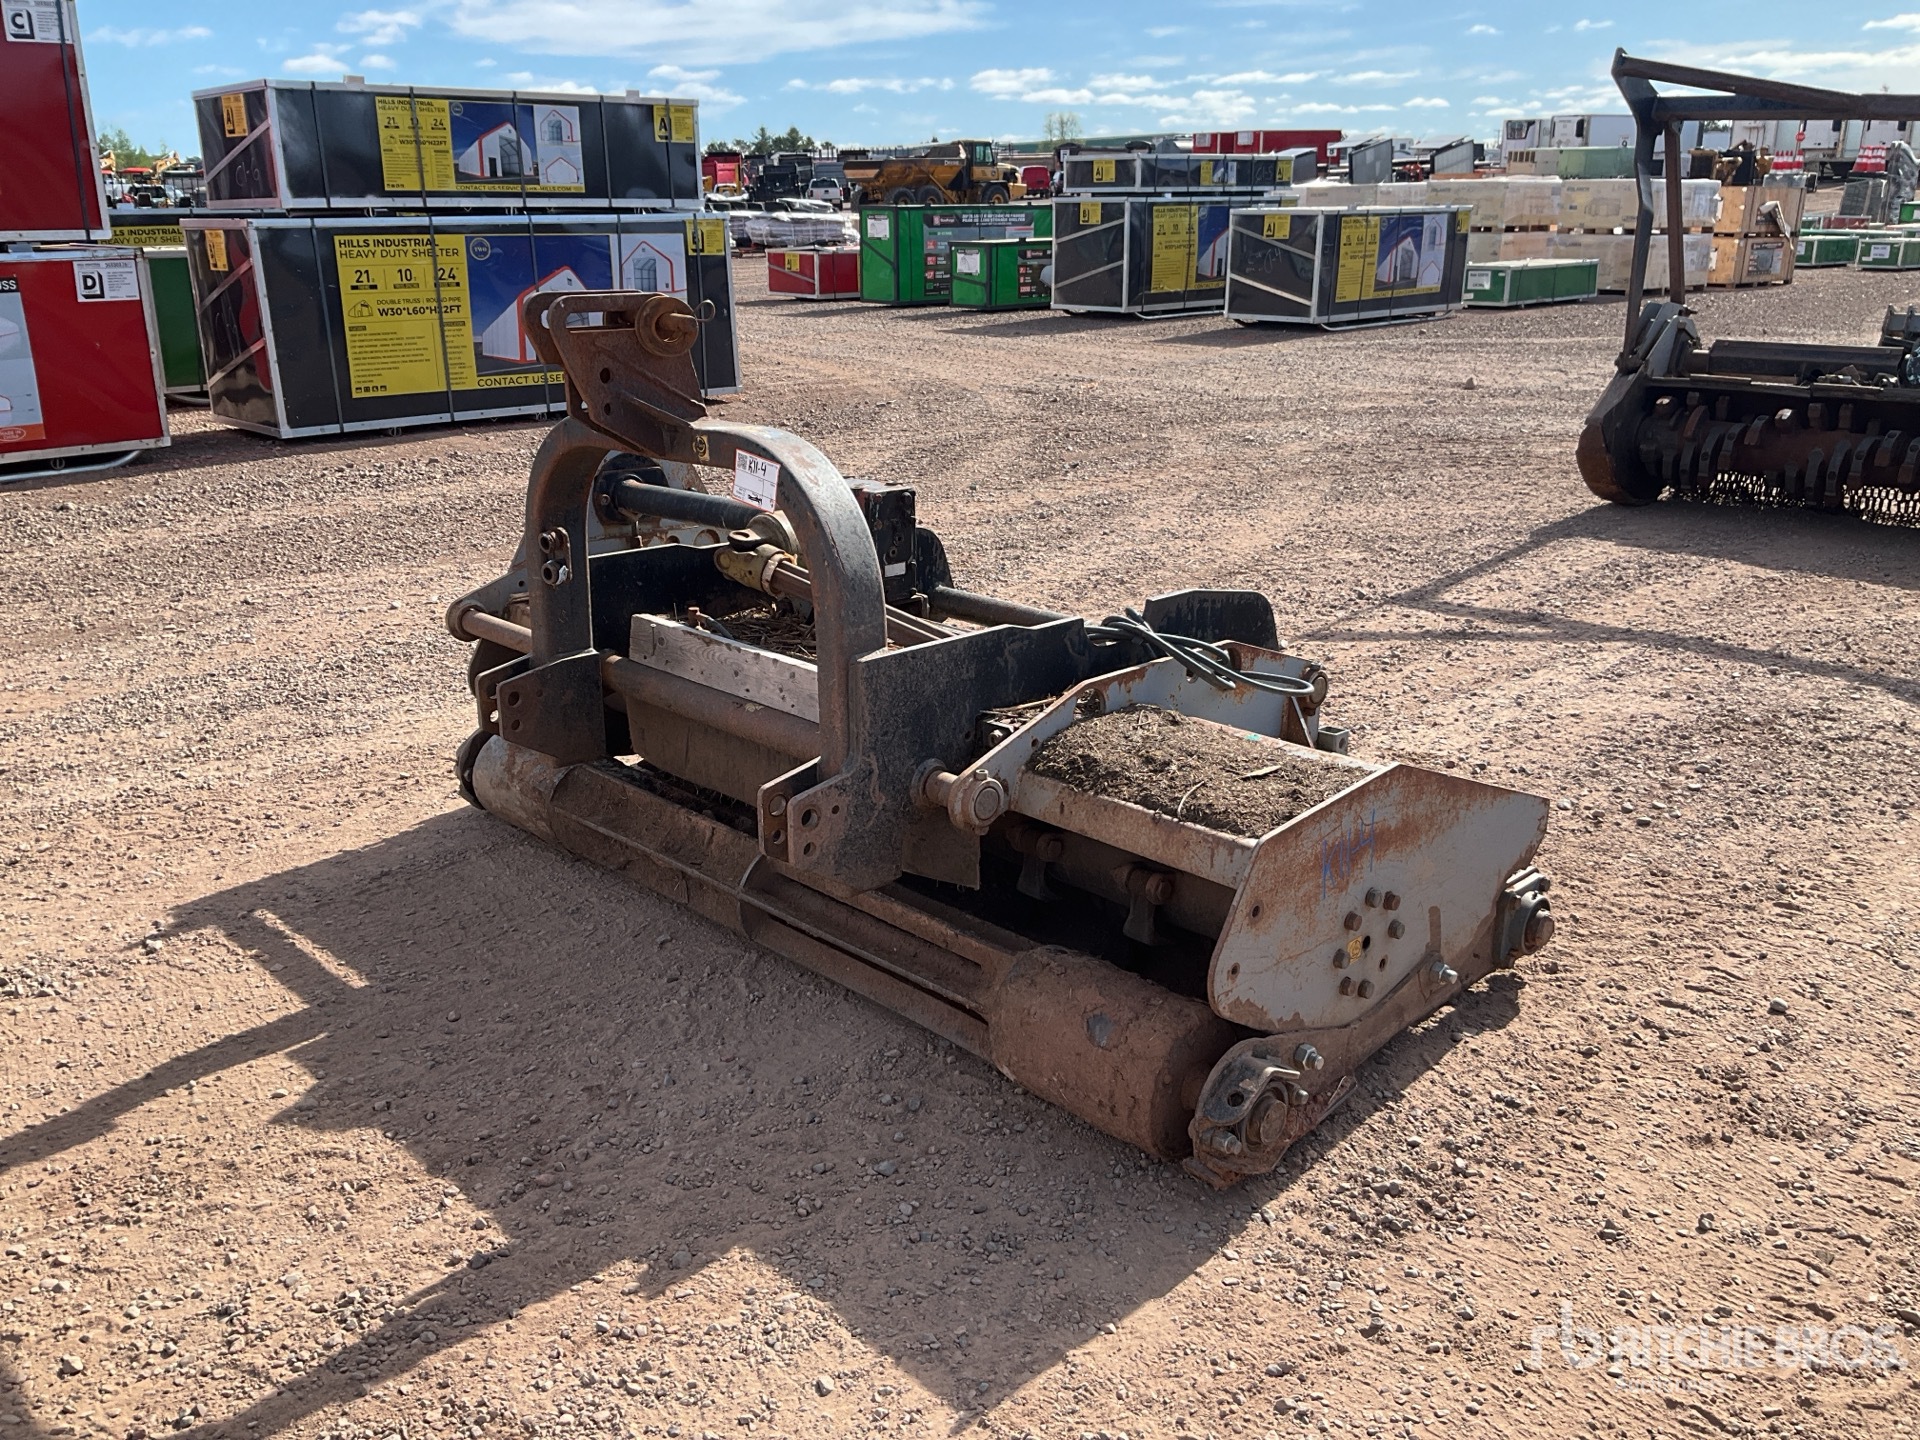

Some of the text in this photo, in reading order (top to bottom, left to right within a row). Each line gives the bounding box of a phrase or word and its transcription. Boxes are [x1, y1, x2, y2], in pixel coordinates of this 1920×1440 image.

[11, 12, 25, 29] C
[387, 116, 396, 125] 21
[659, 117, 667, 131] A
[128, 228, 182, 236] INDUSTRIAL
[1266, 223, 1272, 233] A
[133, 236, 157, 244] DUTY
[338, 237, 439, 248] HILLS INDUSTRIAL
[340, 249, 377, 258] HEAVY
[380, 249, 409, 257] DUTY
[354, 269, 371, 283] 21
[396, 268, 413, 282] 10
[82, 274, 97, 290] D
[477, 375, 529, 387] CONTACT
